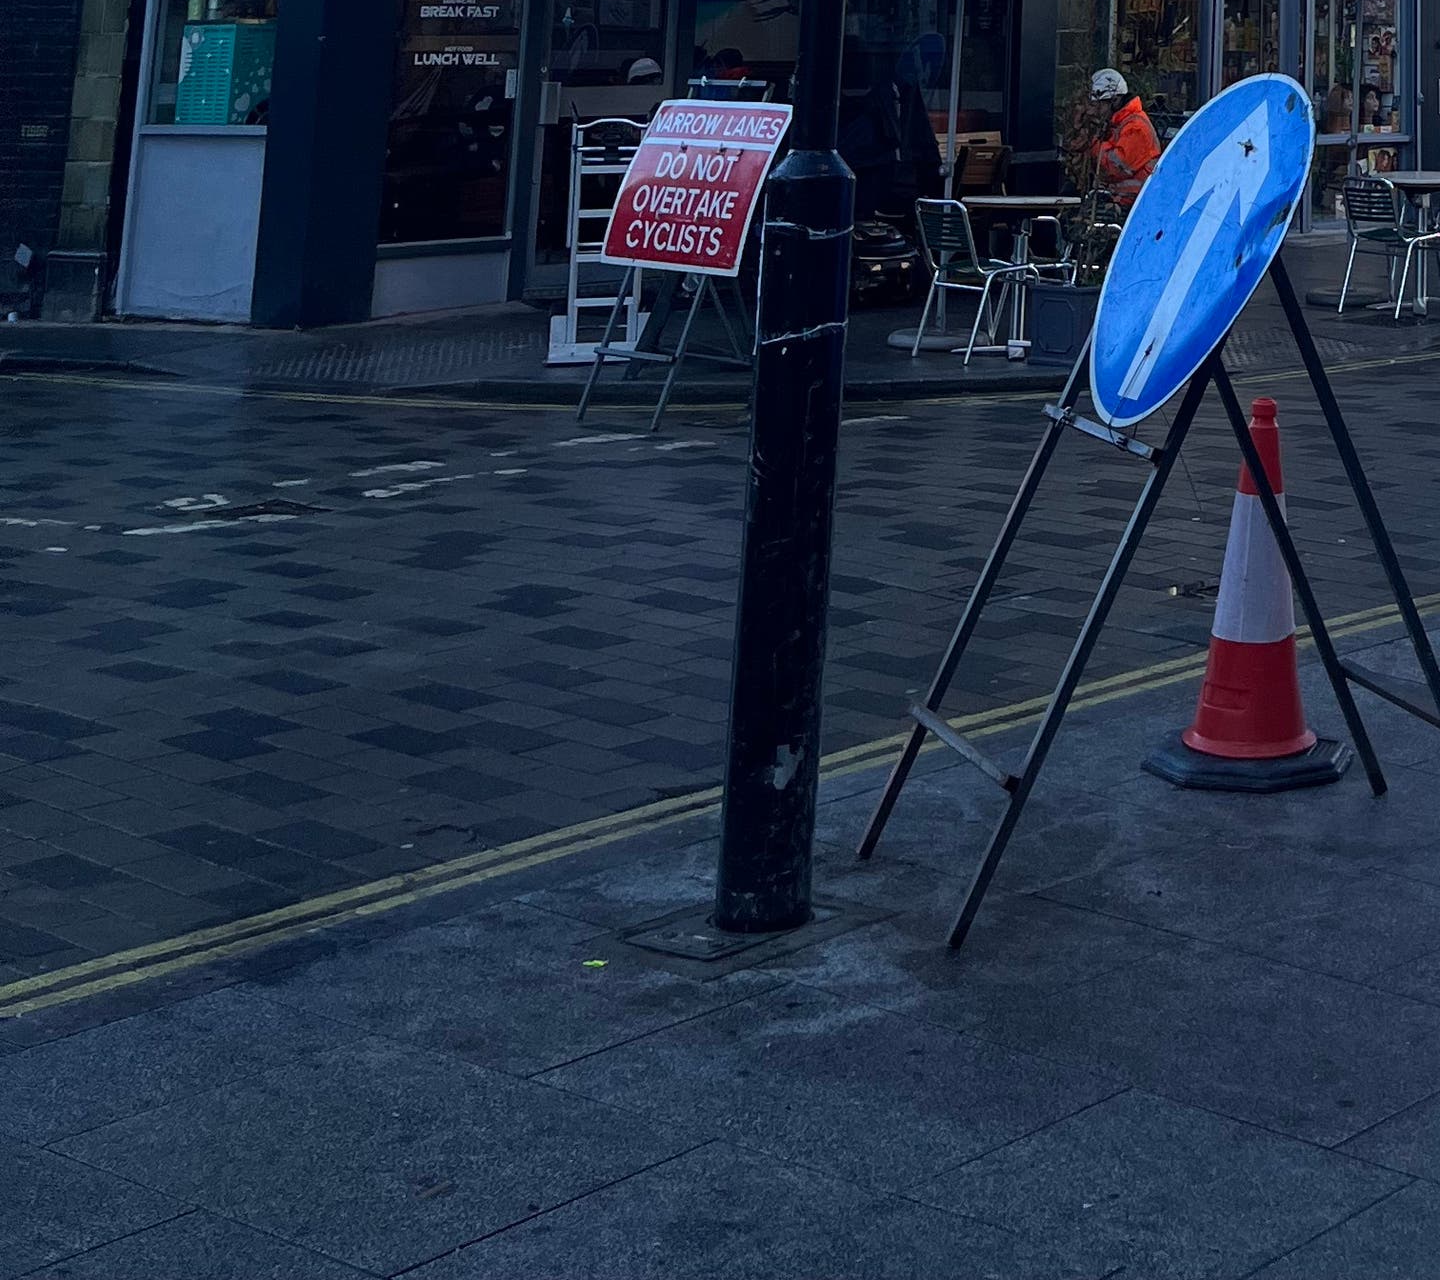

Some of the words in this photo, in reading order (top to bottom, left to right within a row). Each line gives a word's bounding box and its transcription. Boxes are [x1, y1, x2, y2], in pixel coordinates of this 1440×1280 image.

[420, 6, 463, 18] BREAK
[467, 6, 500, 18] FAST
[414, 53, 459, 66] LUNCH
[462, 53, 500, 66] WELL
[655, 112, 723, 136] NARROW
[723, 115, 784, 140] LANES
[655, 151, 687, 180] DO
[690, 154, 739, 183] NOT
[633, 185, 739, 220] OVERTAKE
[626, 220, 723, 256] CYCLISTS
